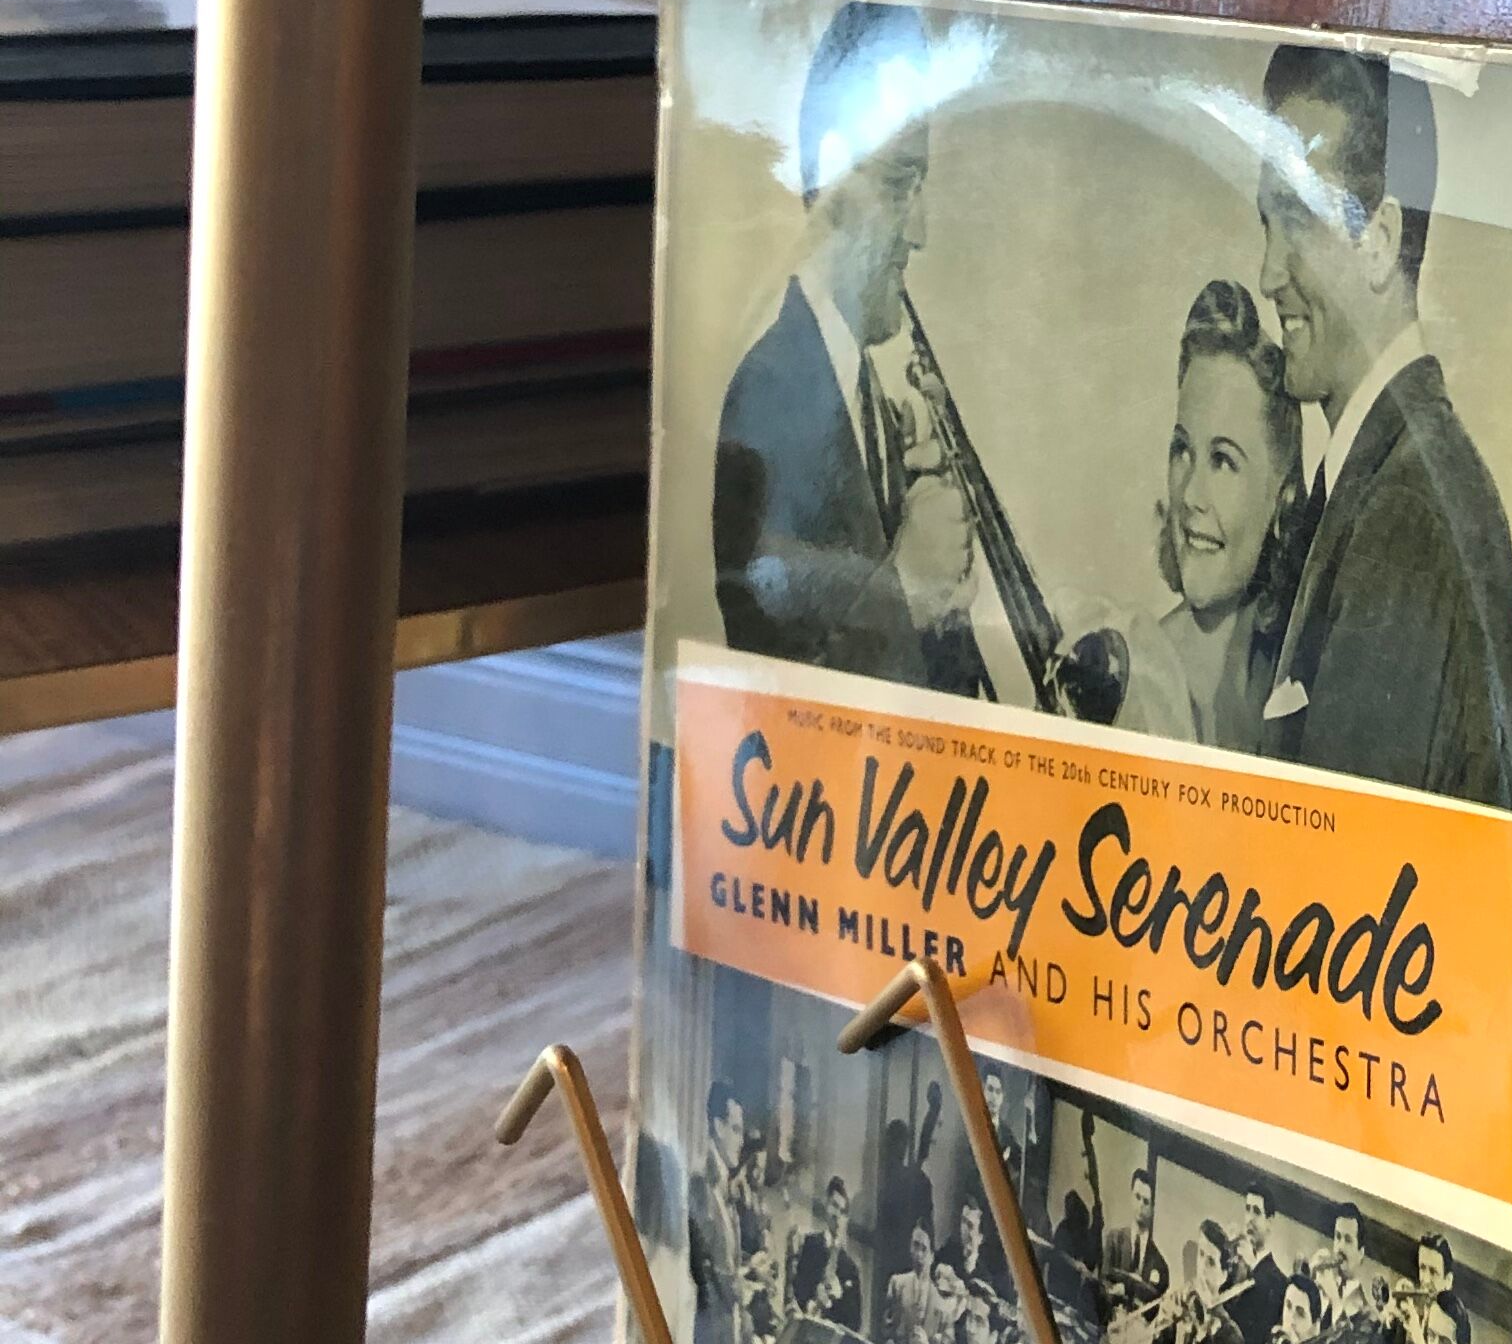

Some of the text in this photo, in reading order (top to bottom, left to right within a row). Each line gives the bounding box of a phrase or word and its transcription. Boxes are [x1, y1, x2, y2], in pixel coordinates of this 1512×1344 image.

[721, 730, 1443, 1036] Sun Valley Serenade
[831, 718, 863, 737] FROM
[869, 723, 892, 745] THE
[897, 730, 946, 755] SOUND
[951, 739, 997, 766] TRACK
[1003, 749, 1022, 769] OF
[1027, 753, 1056, 778] THE
[1061, 760, 1092, 785] 20th
[1098, 768, 1171, 799] CENTURY
[1178, 783, 1212, 809] FOX
[1221, 792, 1336, 833] PRODUCTION
[710, 871, 1446, 1124] GLENN MILLER AND HIS ORCHESTRA
